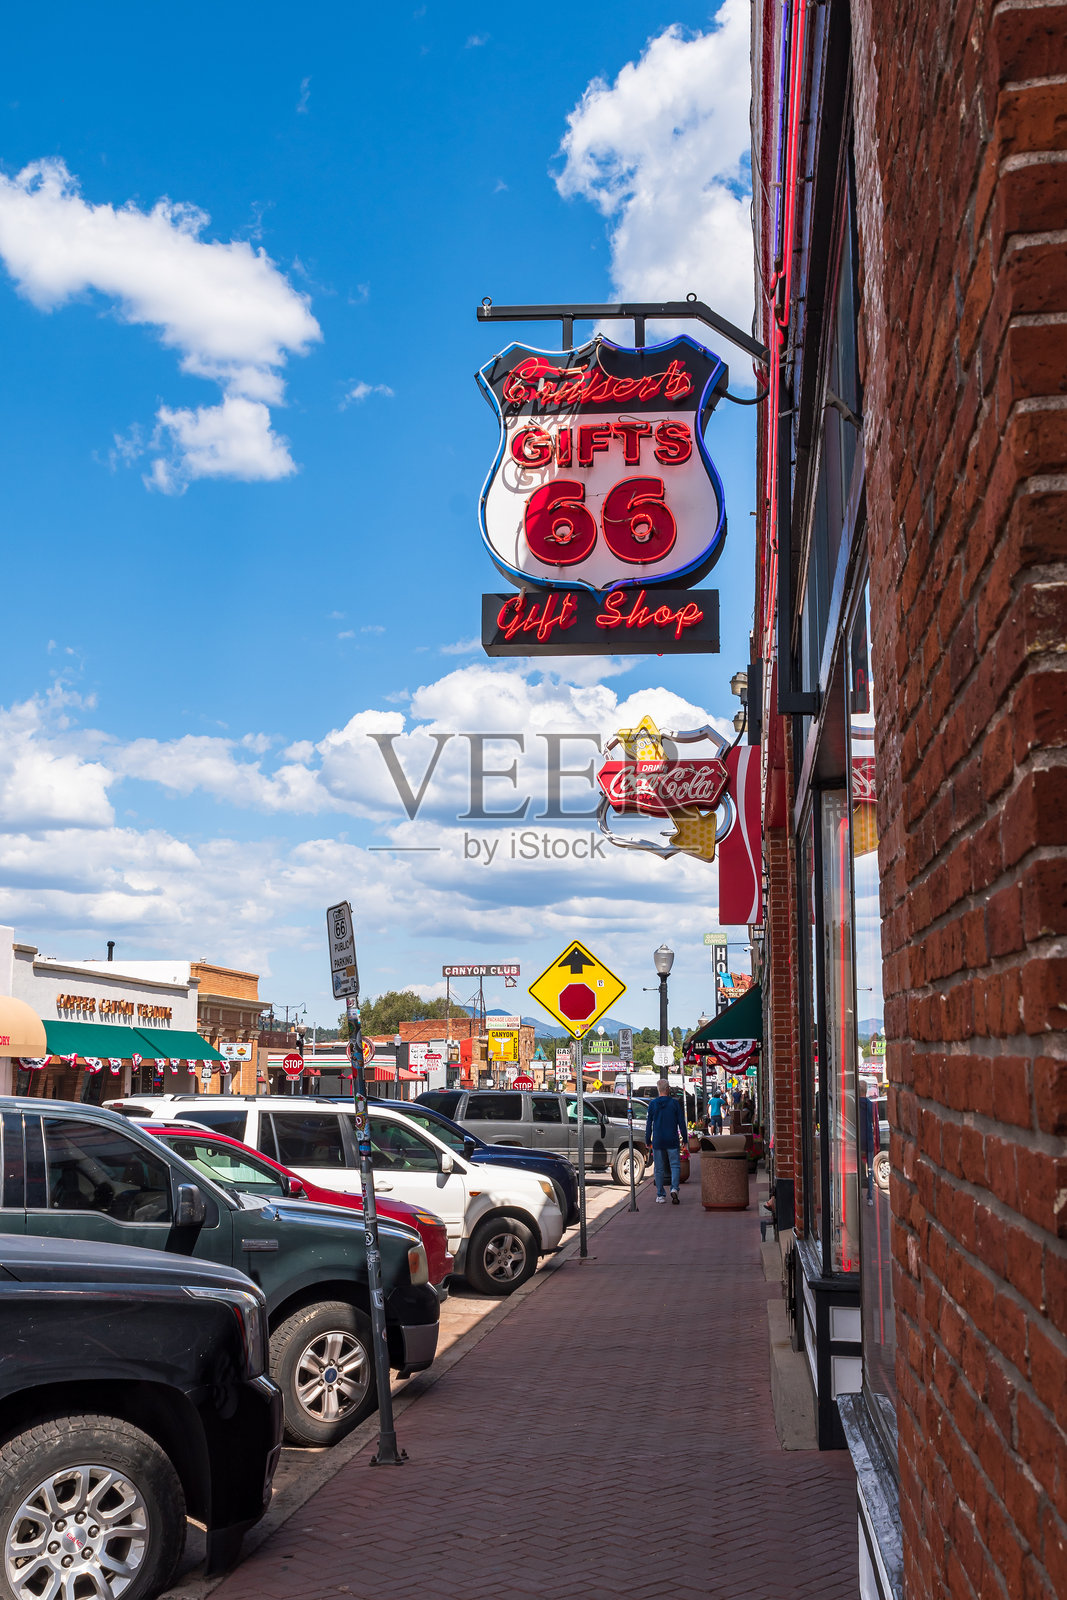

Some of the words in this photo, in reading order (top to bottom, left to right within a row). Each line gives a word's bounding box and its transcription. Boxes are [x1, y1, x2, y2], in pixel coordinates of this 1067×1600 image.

[509, 419, 693, 469] GIFTS
[523, 475, 677, 566] 66
[497, 593, 577, 641] Gift
[596, 590, 703, 640] Shop
[642, 764, 668, 772] DRINK
[335, 920, 346, 937] 66
[334, 940, 350, 952] PUBLIC
[334, 955, 353, 968] PARKING
[445, 967, 486, 975] CANYON
[490, 966, 518, 975] CLUB
[56, 993, 96, 1013] COPPER
[284, 1060, 303, 1069] STOP
[66, 1532, 84, 1549] GMC
